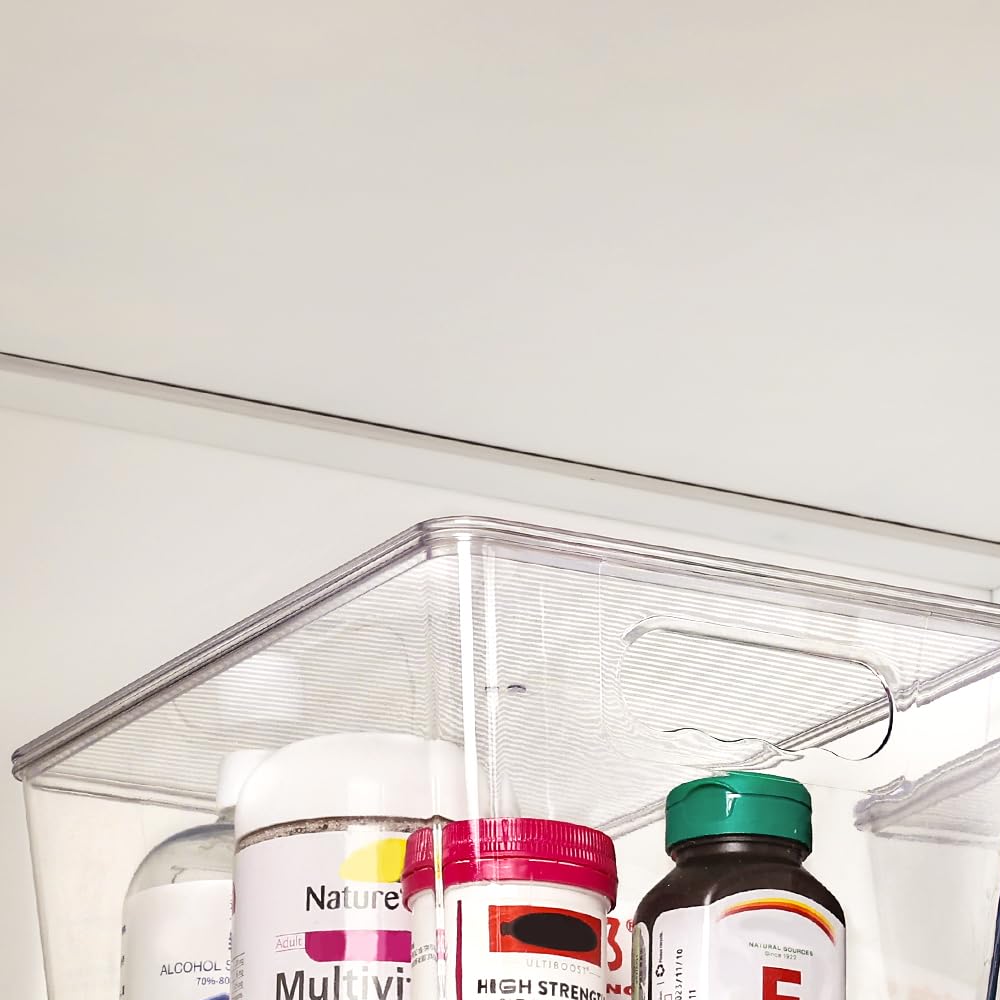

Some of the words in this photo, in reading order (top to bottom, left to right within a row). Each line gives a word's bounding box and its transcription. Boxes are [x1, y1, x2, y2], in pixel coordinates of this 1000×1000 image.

[276, 936, 302, 950] Adult
[749, 942, 781, 952] NATURAL
[783, 946, 814, 957] SOURCES
[764, 950, 782, 958] Since
[160, 960, 222, 976] ALCOHOL
[477, 978, 531, 994] HIGH
